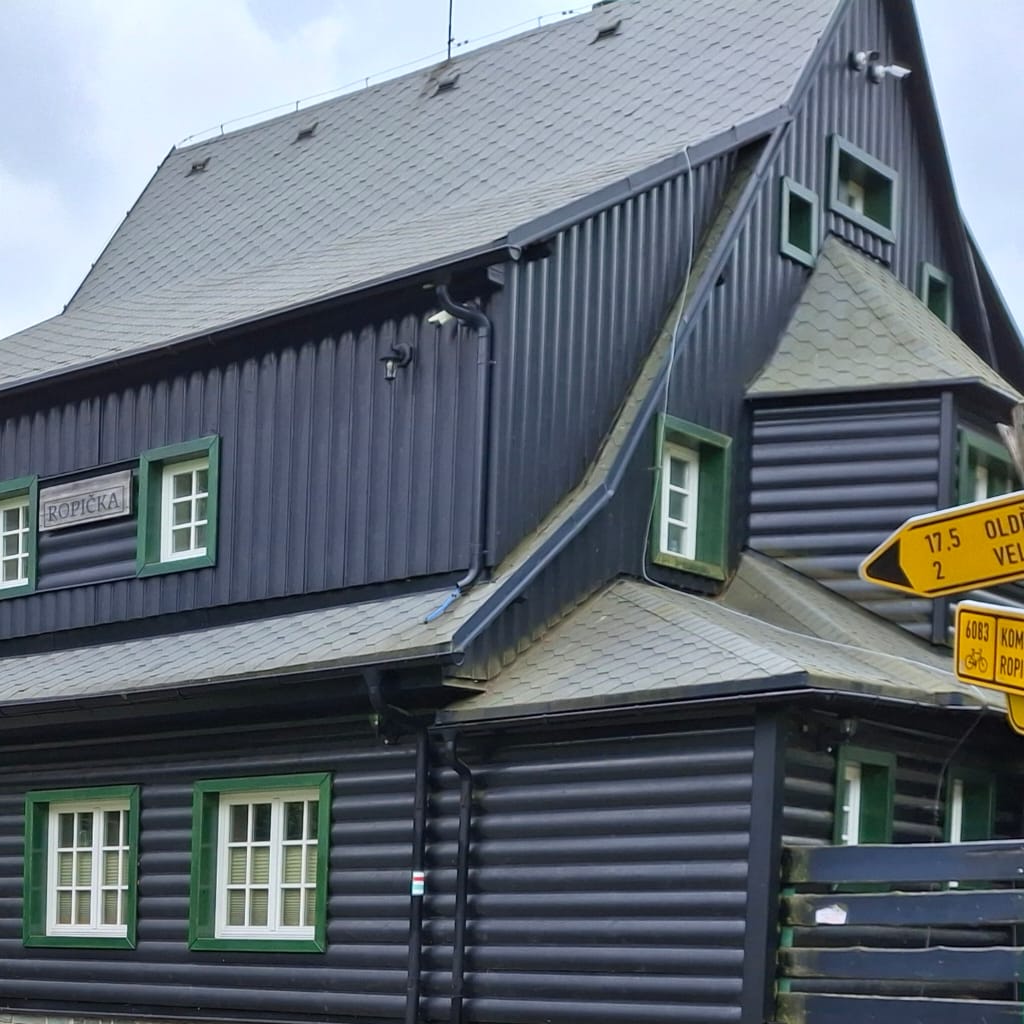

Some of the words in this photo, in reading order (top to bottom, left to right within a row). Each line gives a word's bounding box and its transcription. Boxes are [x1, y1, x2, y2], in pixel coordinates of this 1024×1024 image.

[48, 492, 120, 521] ROPIČKA
[924, 528, 961, 553] 17.5
[933, 561, 945, 580] 2
[965, 620, 989, 642] 6083
[1001, 627, 1024, 650] KOM
[999, 655, 1024, 679] ROPI
